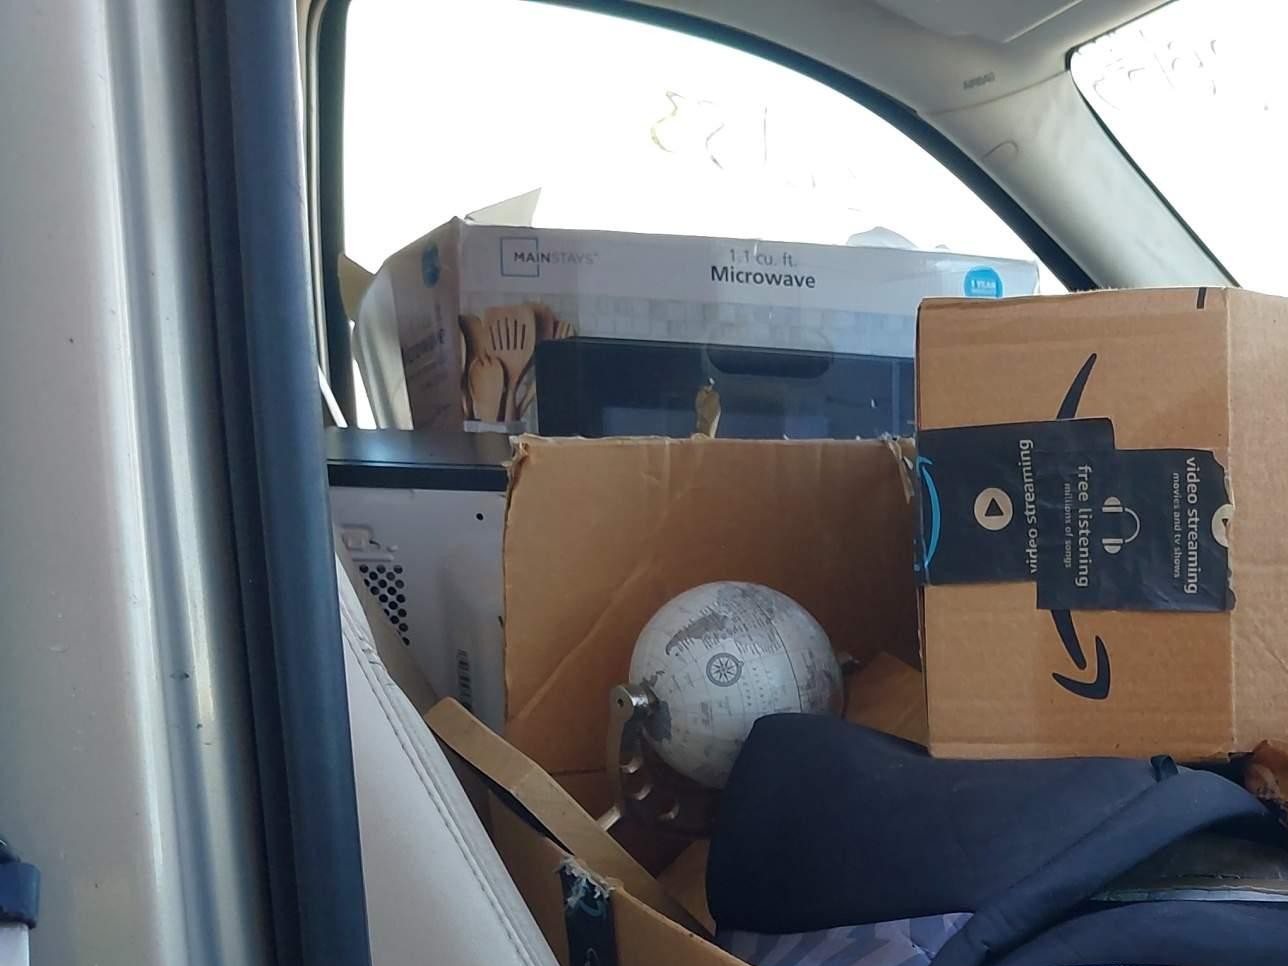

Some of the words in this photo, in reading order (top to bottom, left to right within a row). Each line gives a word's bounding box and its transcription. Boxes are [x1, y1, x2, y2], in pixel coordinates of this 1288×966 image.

[711, 265, 816, 288] Microwave
[755, 253, 777, 267] cu.
[782, 251, 798, 268] ft.
[1018, 439, 1038, 525] streaming
[1078, 463, 1092, 501] free
[1172, 472, 1182, 510] movies
[1186, 456, 1201, 504] video
[1064, 483, 1073, 524] millions
[1173, 511, 1182, 531] and
[1026, 528, 1038, 573] video
[1064, 528, 1074, 537] of
[1075, 507, 1093, 587] listening
[1173, 533, 1182, 545] tv
[1184, 508, 1202, 595] streaming
[1063, 540, 1072, 569] songs
[1173, 546, 1183, 578] shows
